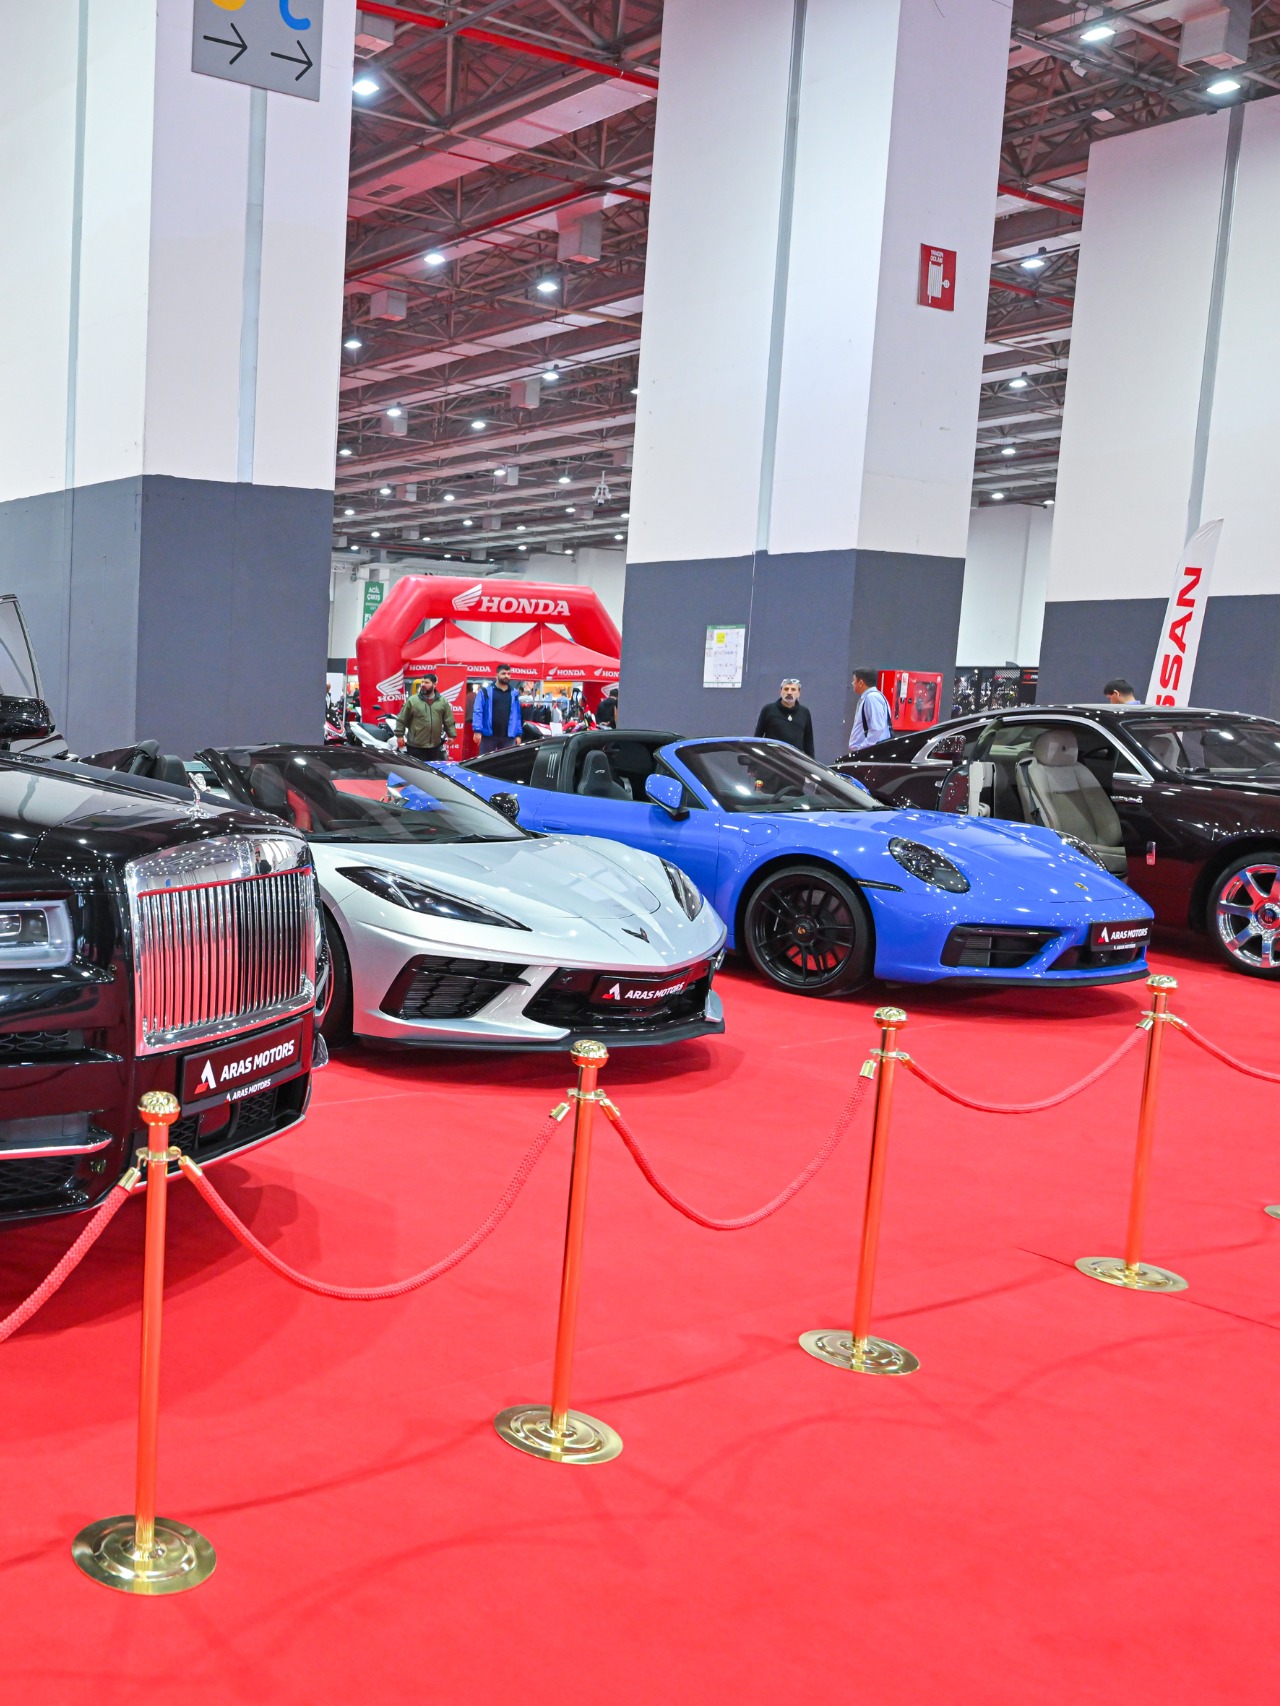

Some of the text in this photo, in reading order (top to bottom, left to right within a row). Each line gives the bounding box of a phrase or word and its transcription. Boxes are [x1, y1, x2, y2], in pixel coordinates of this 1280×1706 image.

[478, 596, 571, 616] HONDA
[466, 665, 492, 673] ONDA
[556, 669, 586, 677] HONDA
[625, 982, 685, 999] ARAS MOTORS
[220, 1039, 295, 1082] ARAS MOTORS
[232, 1079, 271, 1100] ARAS MOTORS
